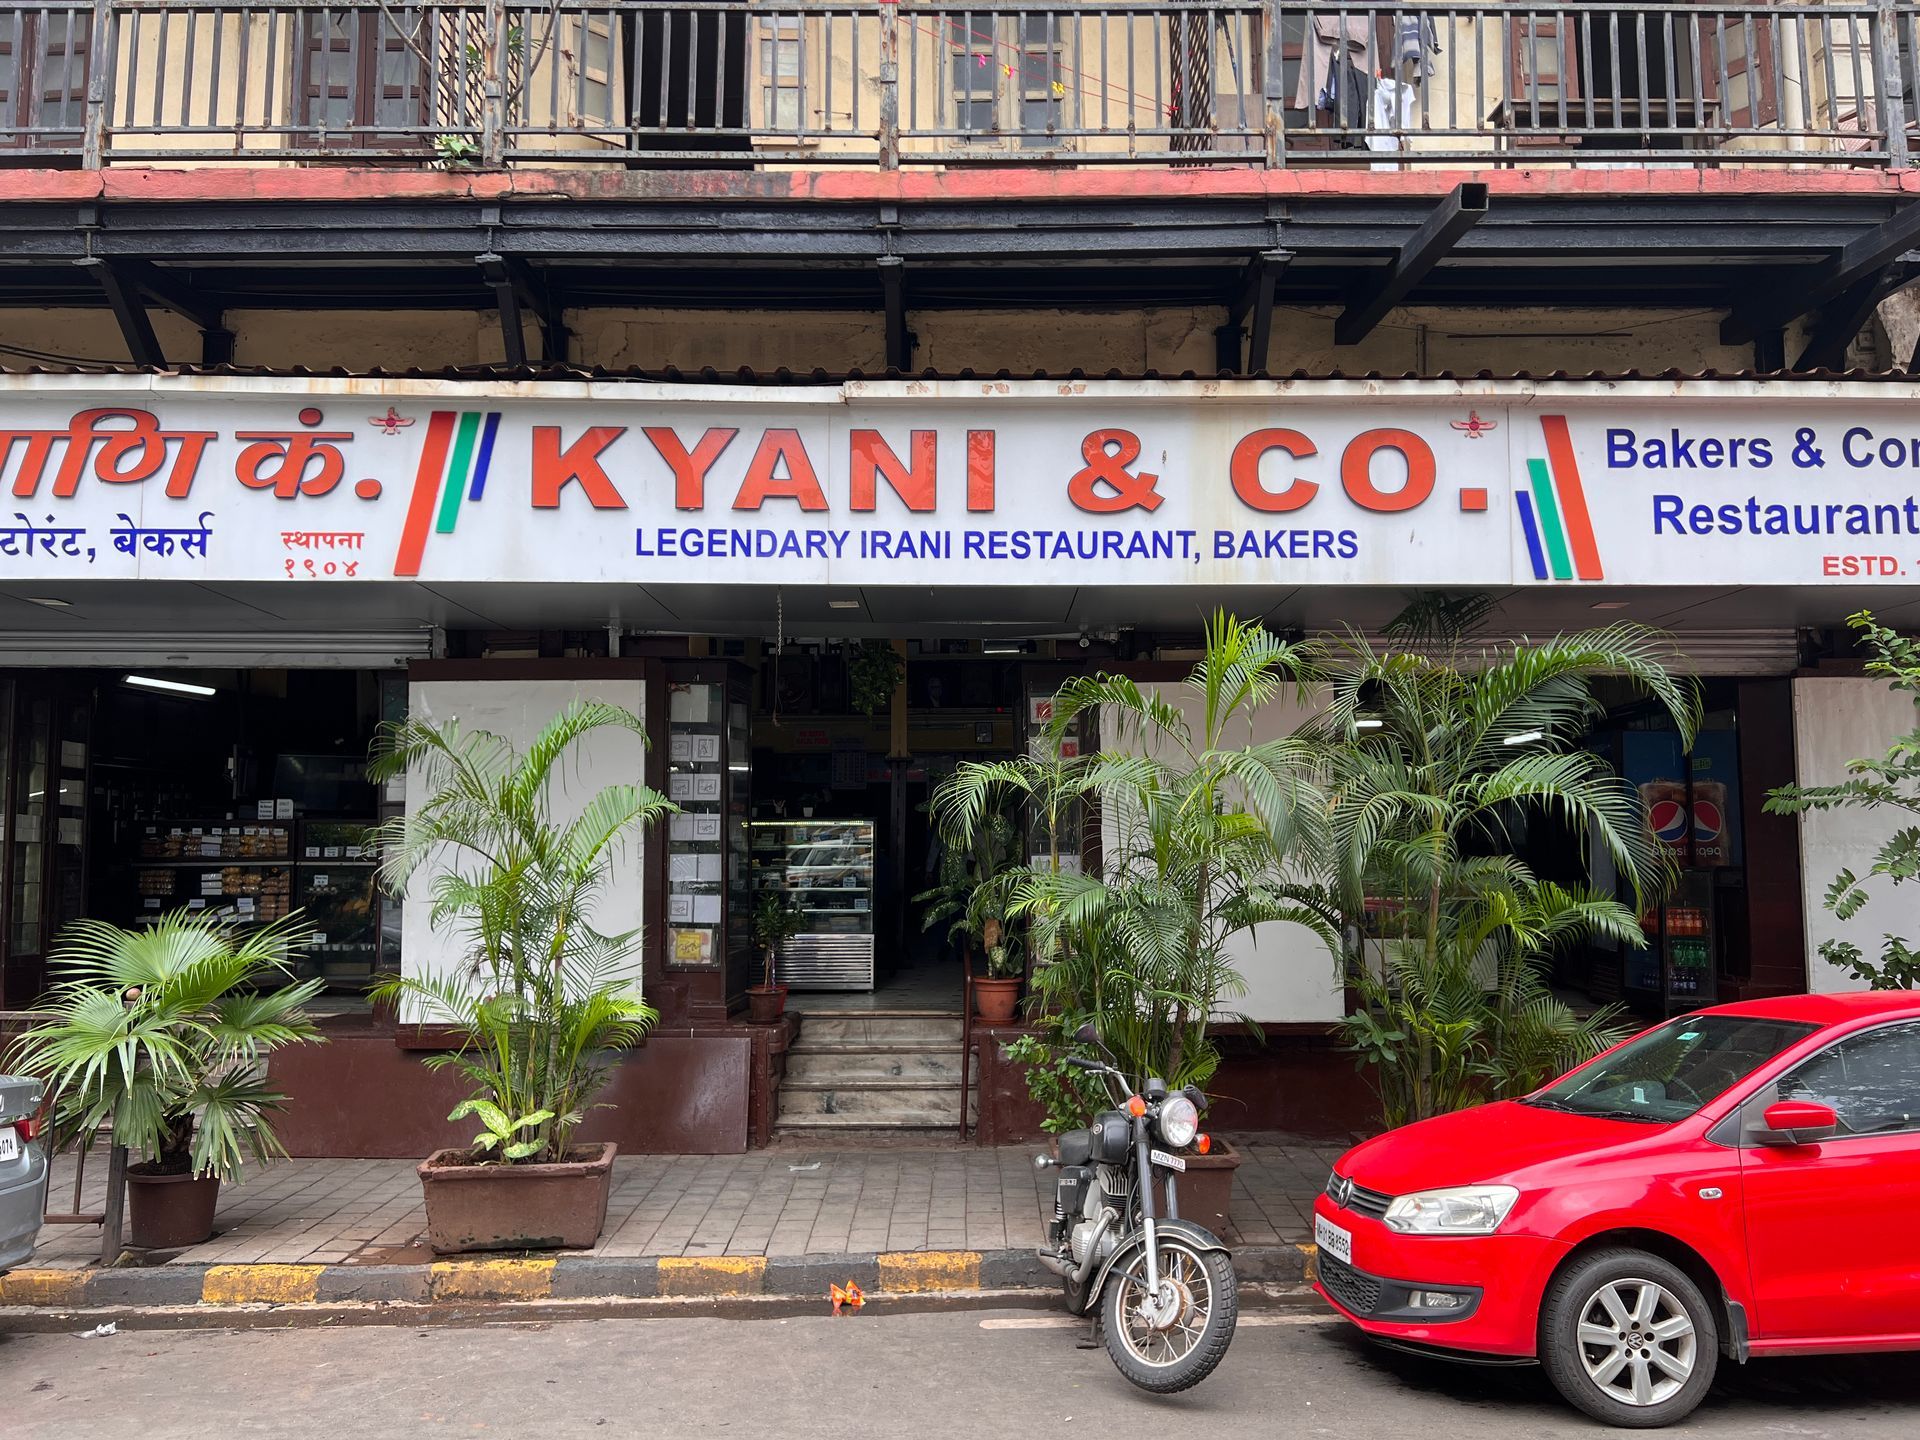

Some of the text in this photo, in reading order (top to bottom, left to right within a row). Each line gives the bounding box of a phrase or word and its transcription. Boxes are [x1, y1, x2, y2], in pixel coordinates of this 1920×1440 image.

[235, 407, 383, 500] कं.
[1606, 428, 1774, 469] Bakers
[1790, 427, 1826, 469] &
[531, 426, 1489, 514] KYANI & CO.
[110, 511, 216, 559] बेकर्स
[1653, 494, 1920, 535] Restaurant
[281, 531, 365, 550] स्थापना
[635, 528, 1358, 564] LEGENDARY IRANI RESTAURANT, BAKERS
[285, 558, 360, 578] १९०४
[1823, 555, 1907, 577] ESTD.
